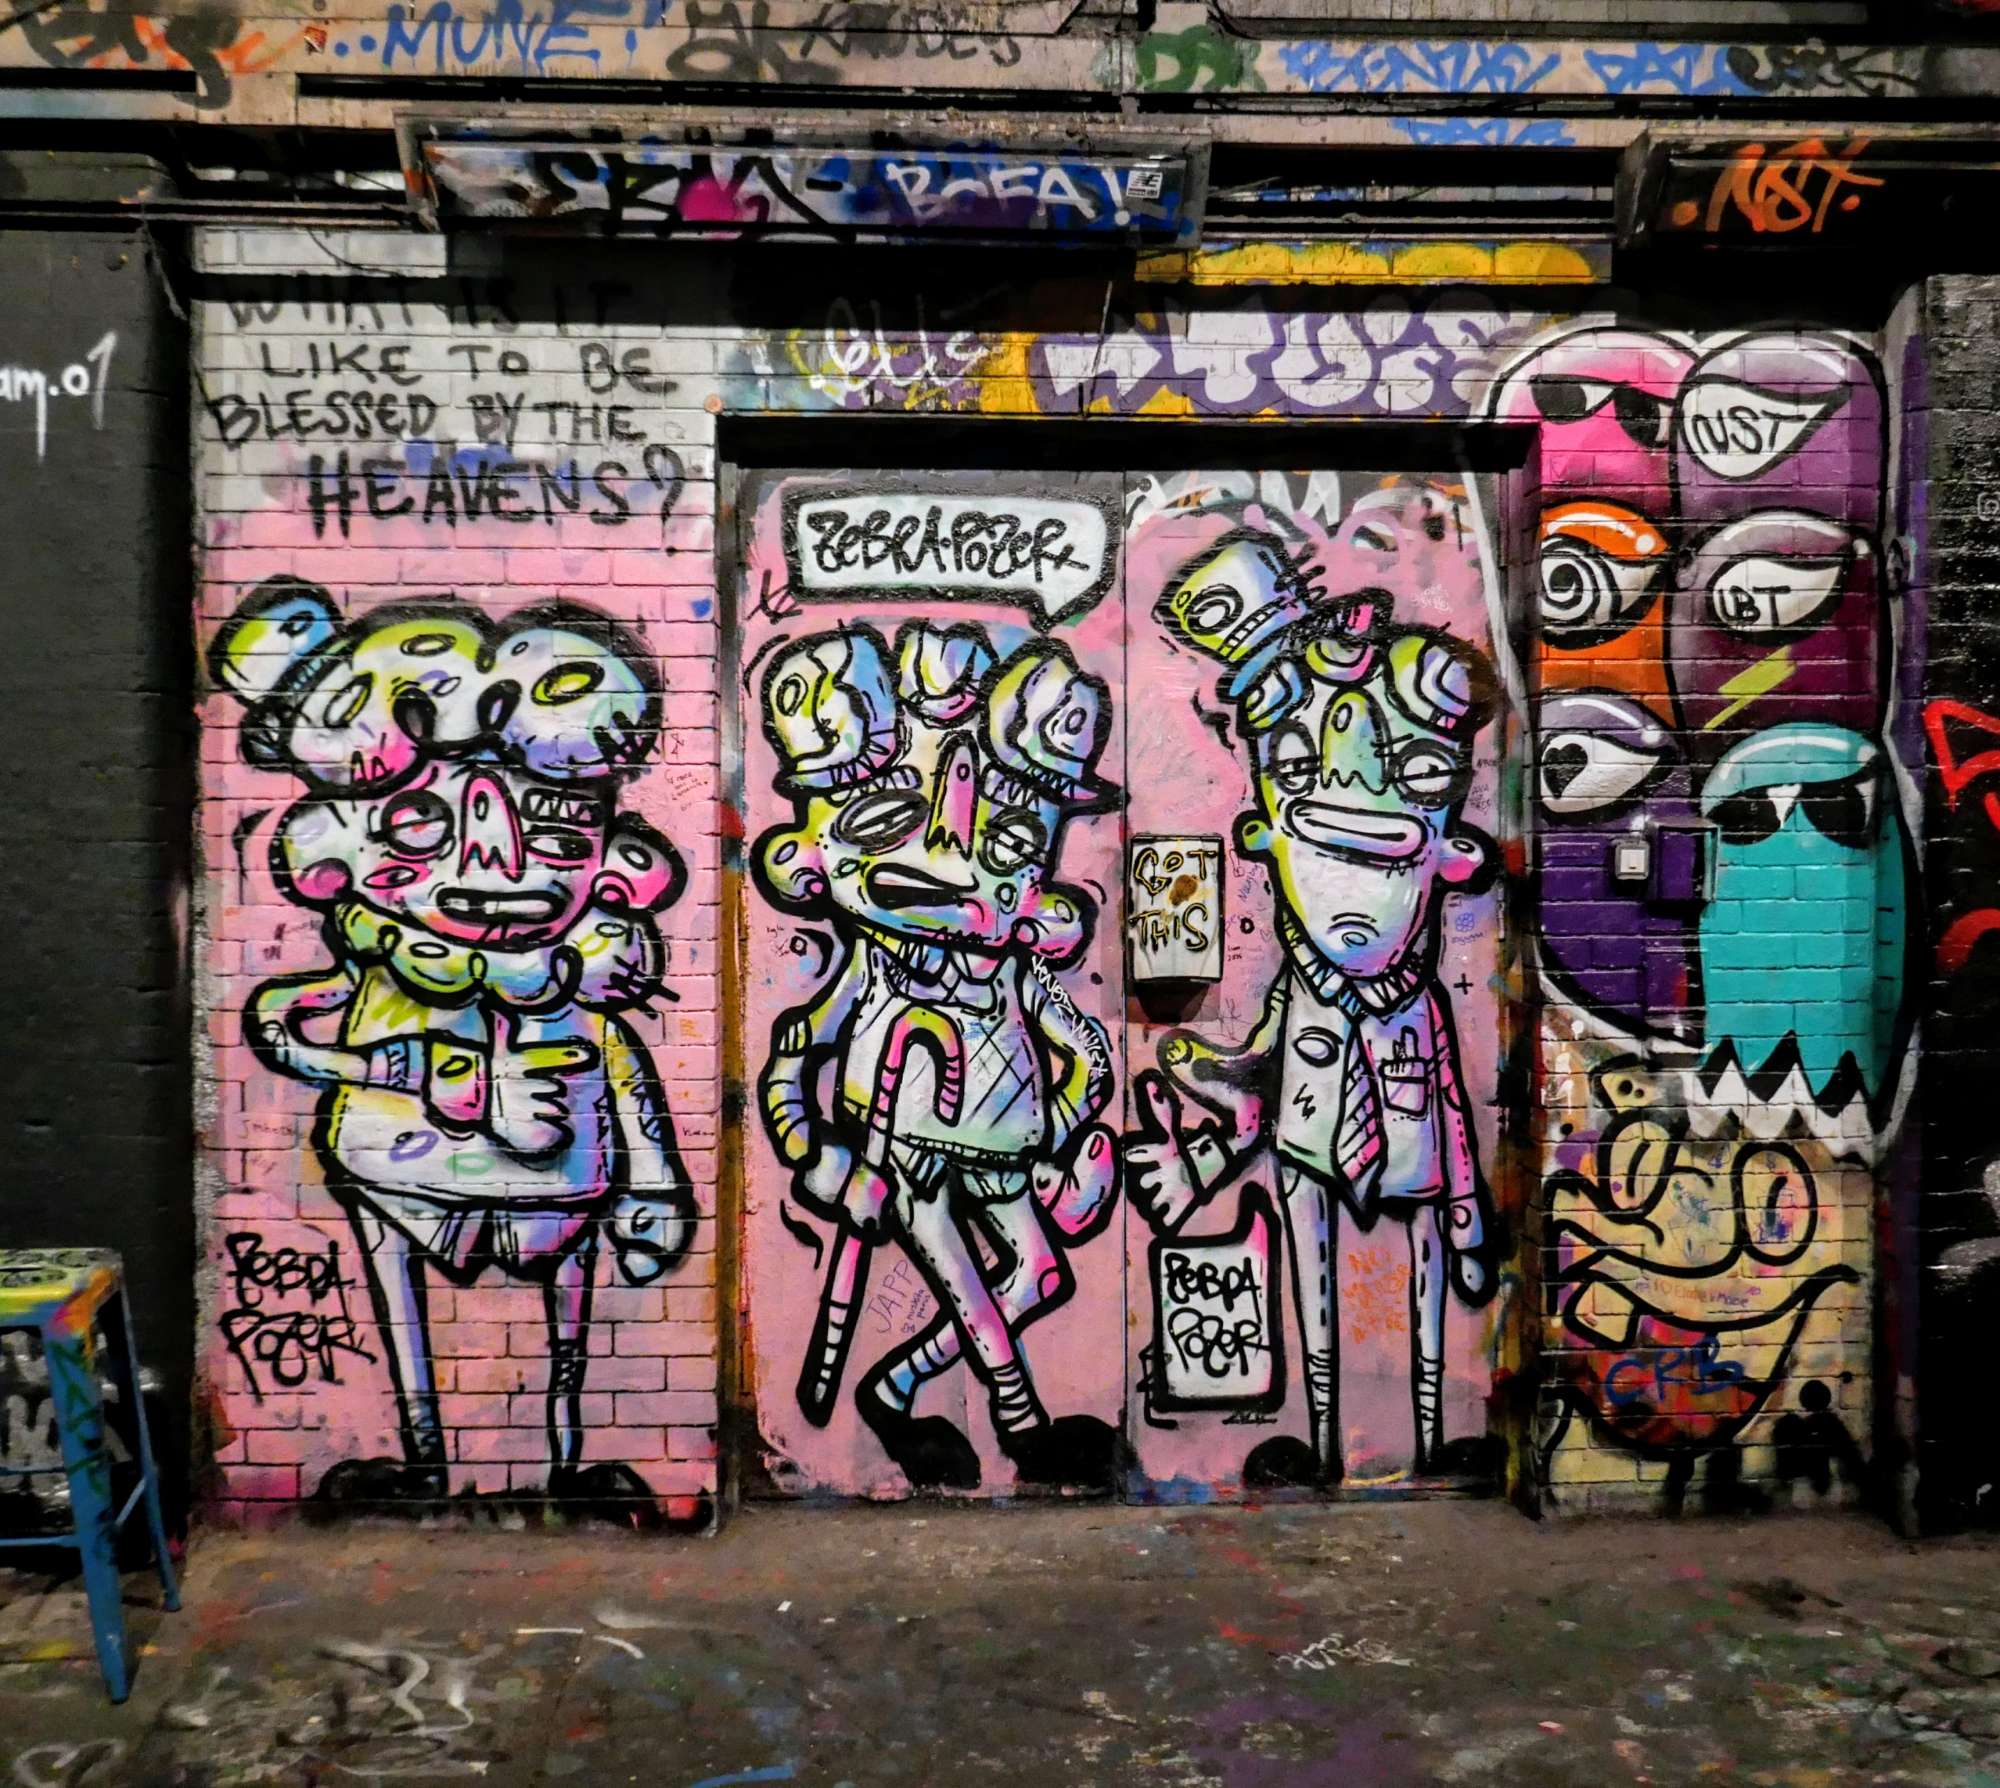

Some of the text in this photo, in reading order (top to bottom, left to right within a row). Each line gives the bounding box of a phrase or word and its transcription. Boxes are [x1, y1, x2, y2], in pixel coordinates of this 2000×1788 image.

[261, 341, 679, 395] LIKE TO BE
[204, 391, 647, 449] BLESSED BY THE
[307, 443, 686, 538] HEAVENS?
[1133, 847, 1219, 896] GOT
[1129, 903, 1209, 953] THIS
